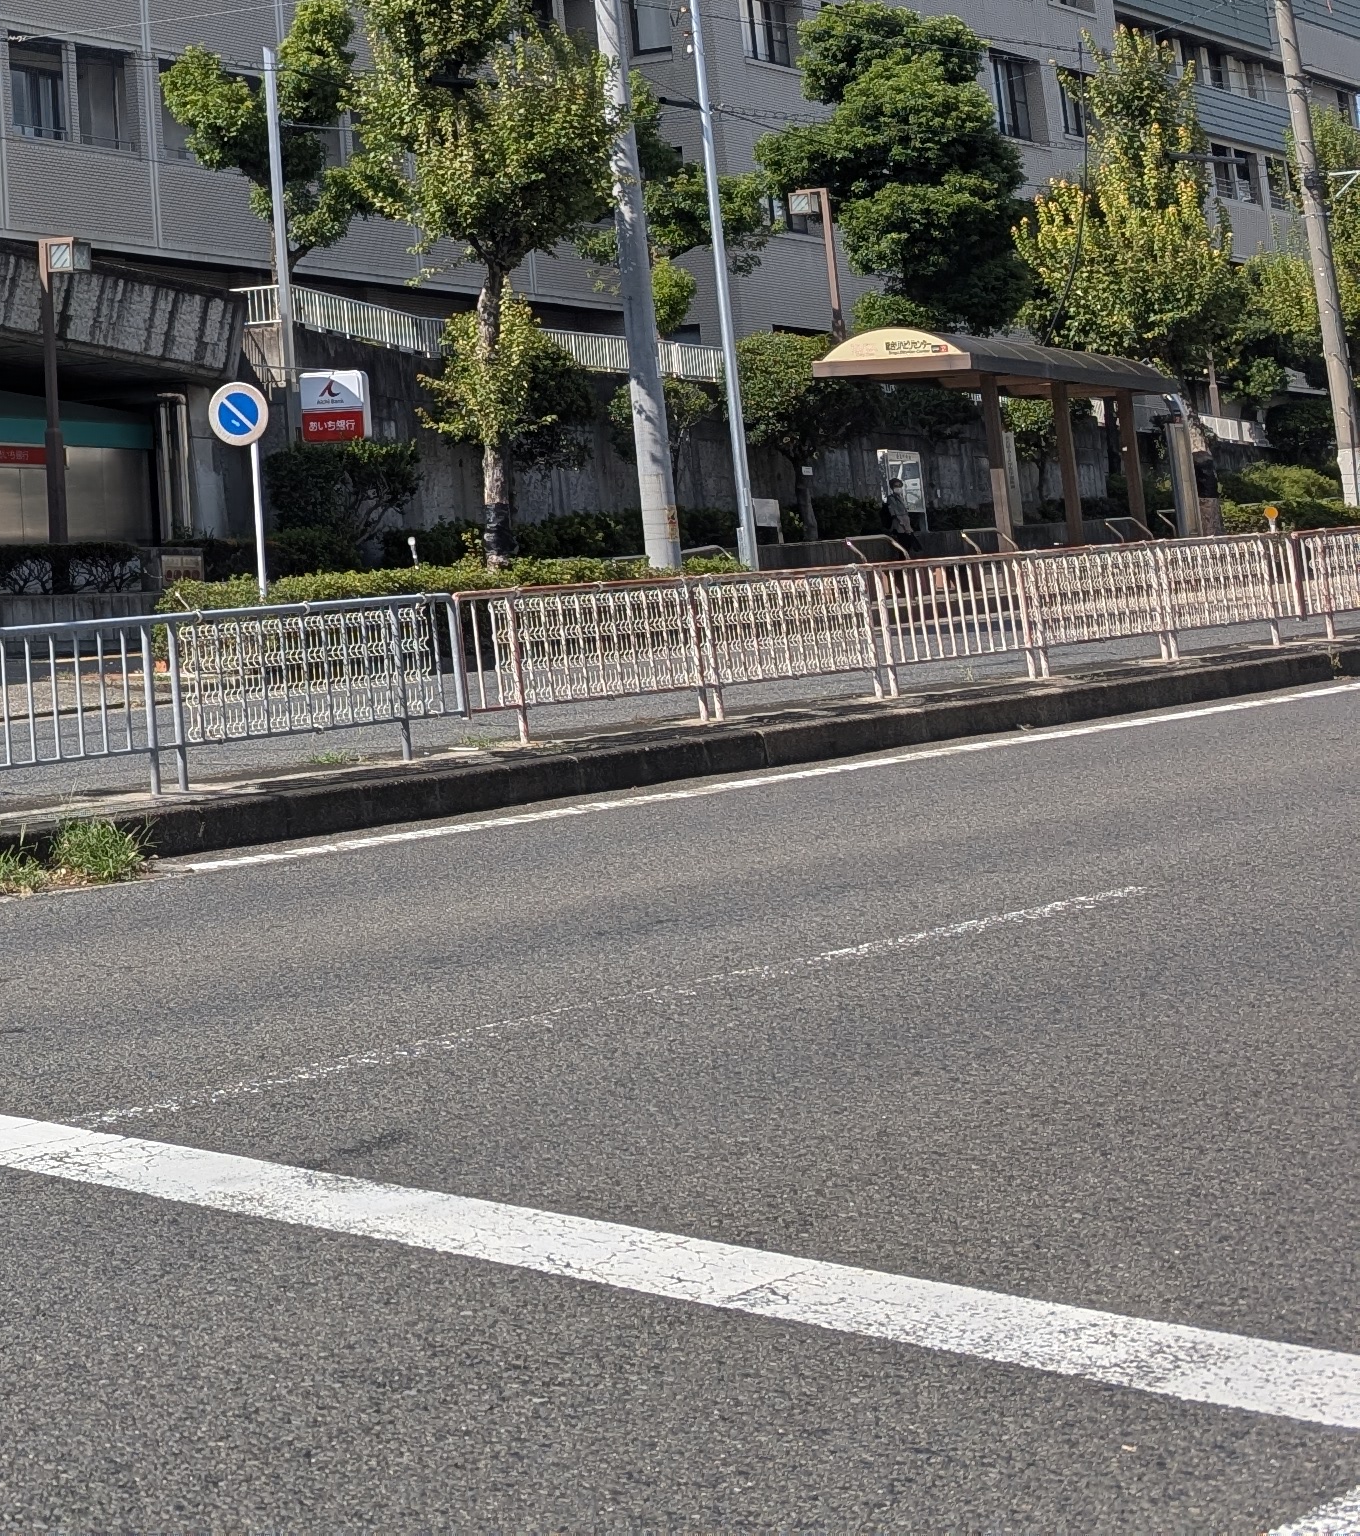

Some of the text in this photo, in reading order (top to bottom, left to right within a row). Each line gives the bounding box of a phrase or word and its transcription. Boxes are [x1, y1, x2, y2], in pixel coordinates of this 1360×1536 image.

[308, 419, 356, 432] あいち銀行
